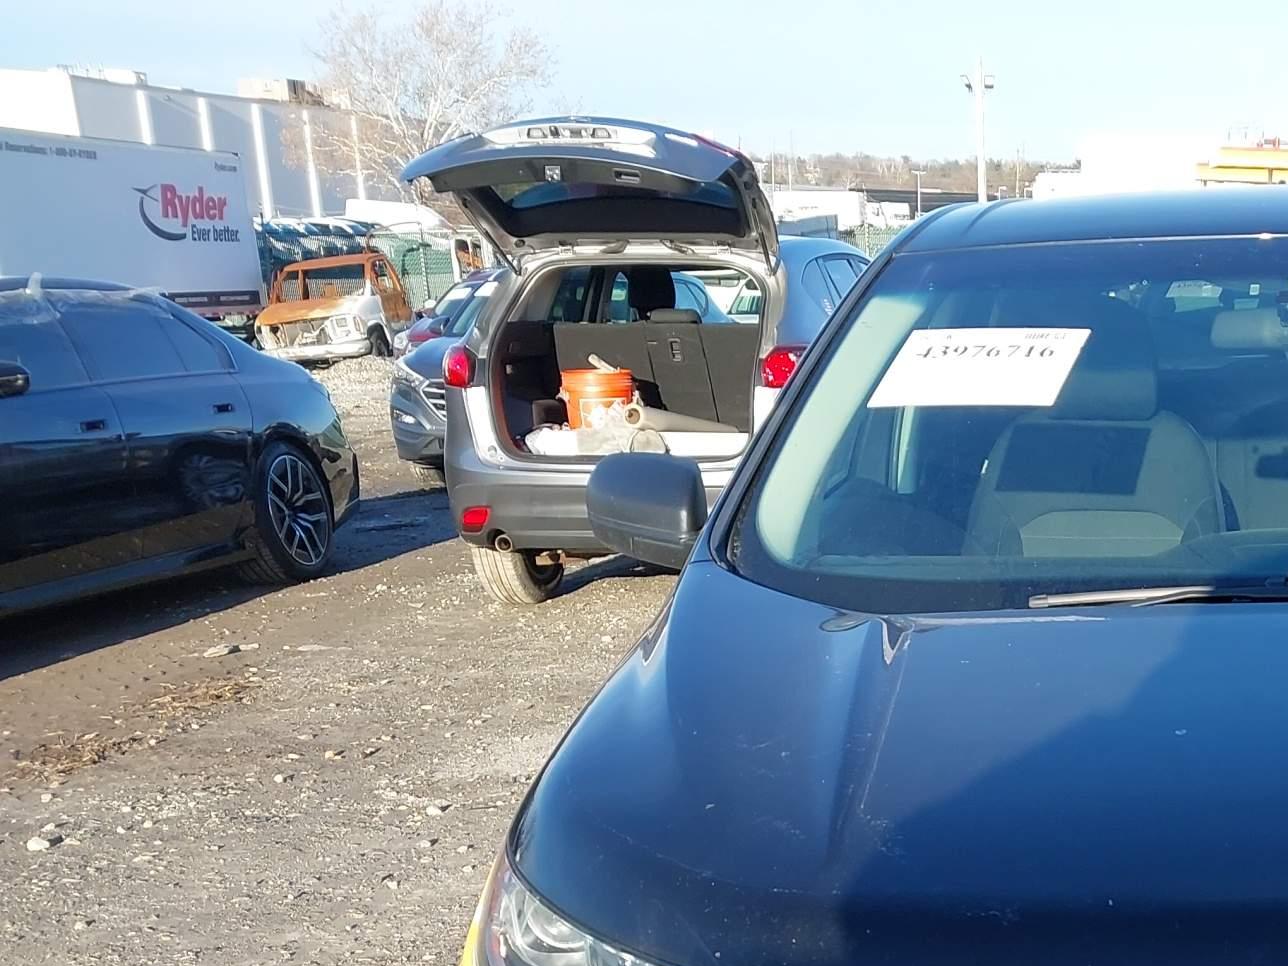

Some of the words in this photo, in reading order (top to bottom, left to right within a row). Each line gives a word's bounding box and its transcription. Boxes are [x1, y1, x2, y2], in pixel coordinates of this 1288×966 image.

[160, 183, 227, 228] Ryder
[191, 224, 211, 241] Ever
[212, 225, 240, 242] better.
[916, 345, 1055, 358] 43976716
